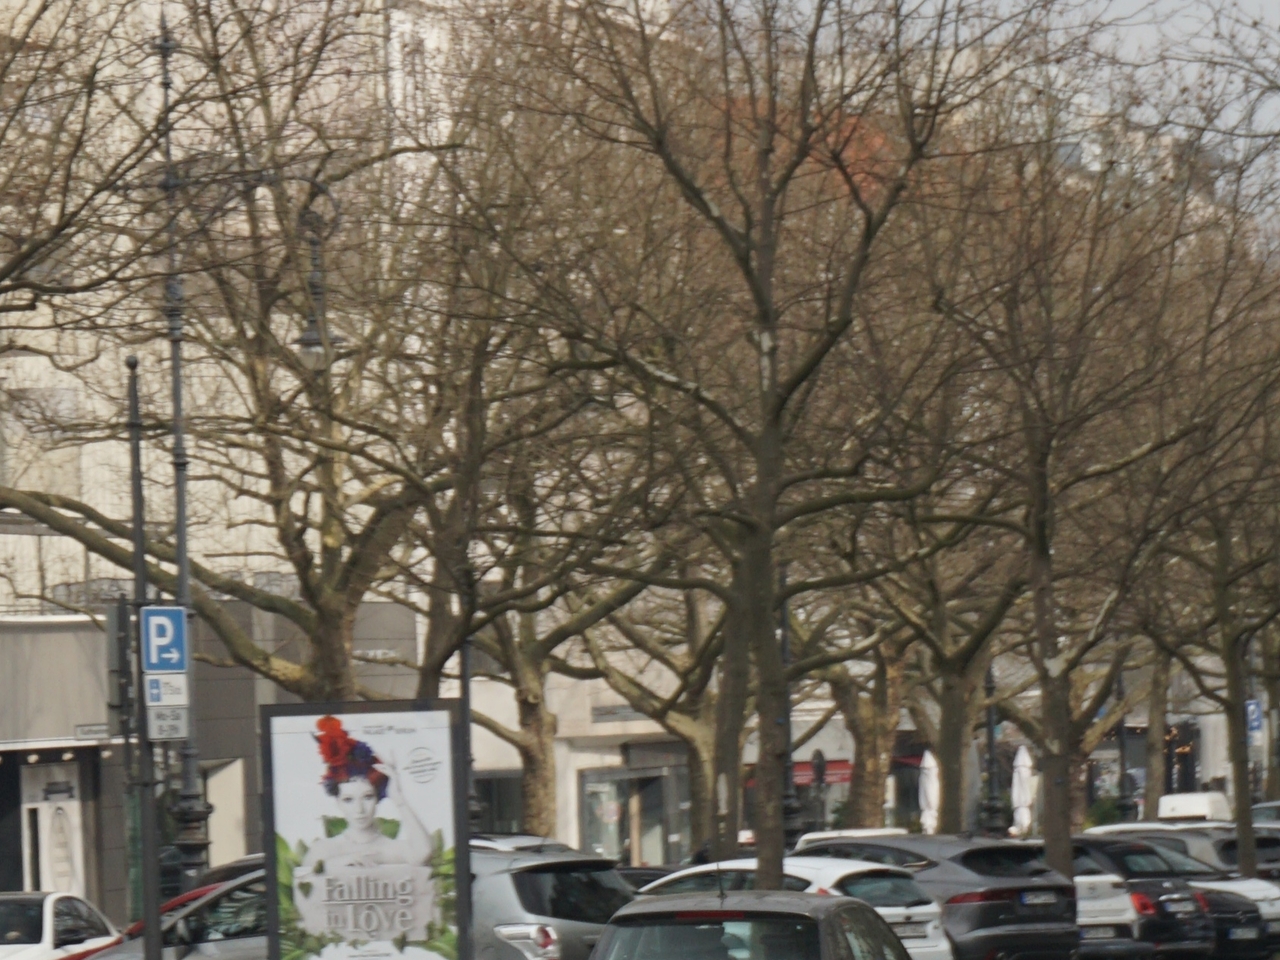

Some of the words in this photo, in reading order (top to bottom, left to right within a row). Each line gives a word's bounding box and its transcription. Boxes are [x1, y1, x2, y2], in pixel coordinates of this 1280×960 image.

[148, 616, 175, 664] P
[325, 876, 414, 907] Falling
[327, 911, 344, 928] in
[345, 903, 413, 937] Love
